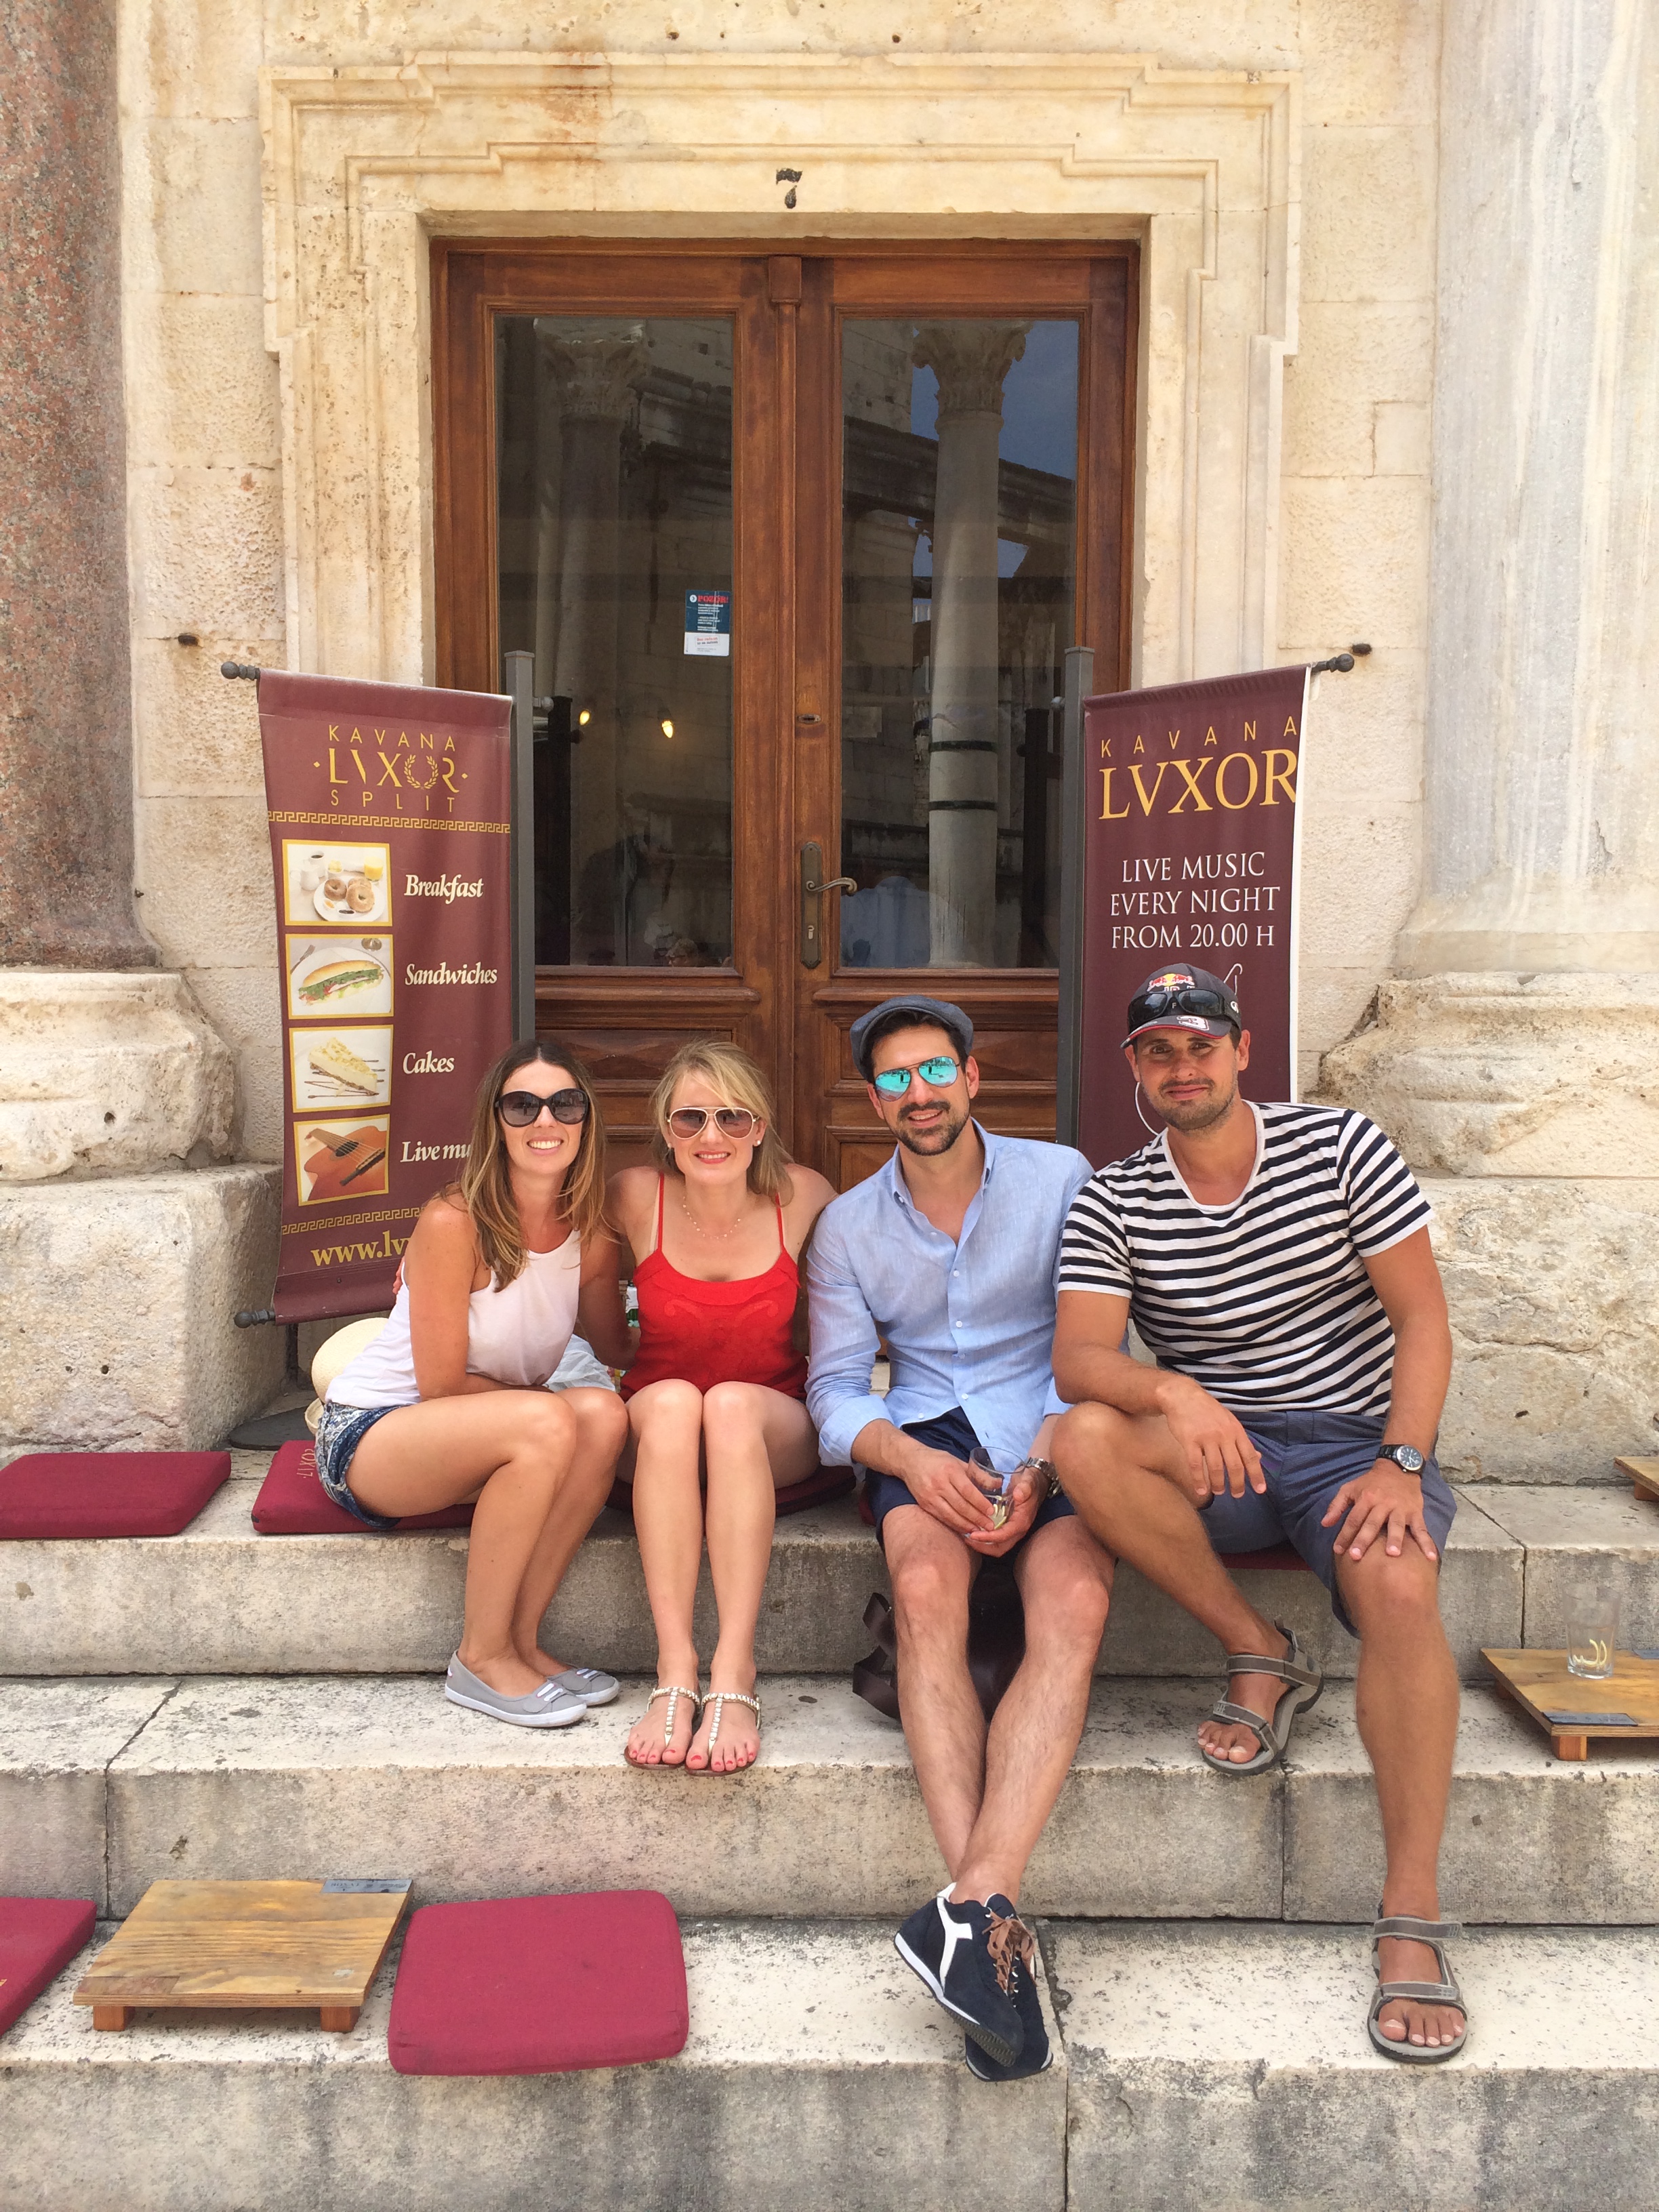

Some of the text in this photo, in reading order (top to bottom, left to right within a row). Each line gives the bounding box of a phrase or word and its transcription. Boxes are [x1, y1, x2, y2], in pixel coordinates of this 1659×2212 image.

[775, 168, 802, 209] 7
[329, 724, 455, 752] KAVANA
[1101, 716, 1297, 758] KAVANA
[1099, 749, 1297, 819] LVXOR
[331, 789, 455, 813] SPLIT
[1122, 851, 1265, 882] LIVE MUSIC
[404, 874, 483, 904] Breakfast
[1110, 886, 1280, 916] EVERY NIGHT
[1112, 923, 1275, 949] FROM 20.00 H
[405, 961, 498, 986] Sandwiches
[402, 1050, 455, 1074] Cakes
[400, 1141, 473, 1162] Live mu
[310, 1230, 411, 1266] www.lv
